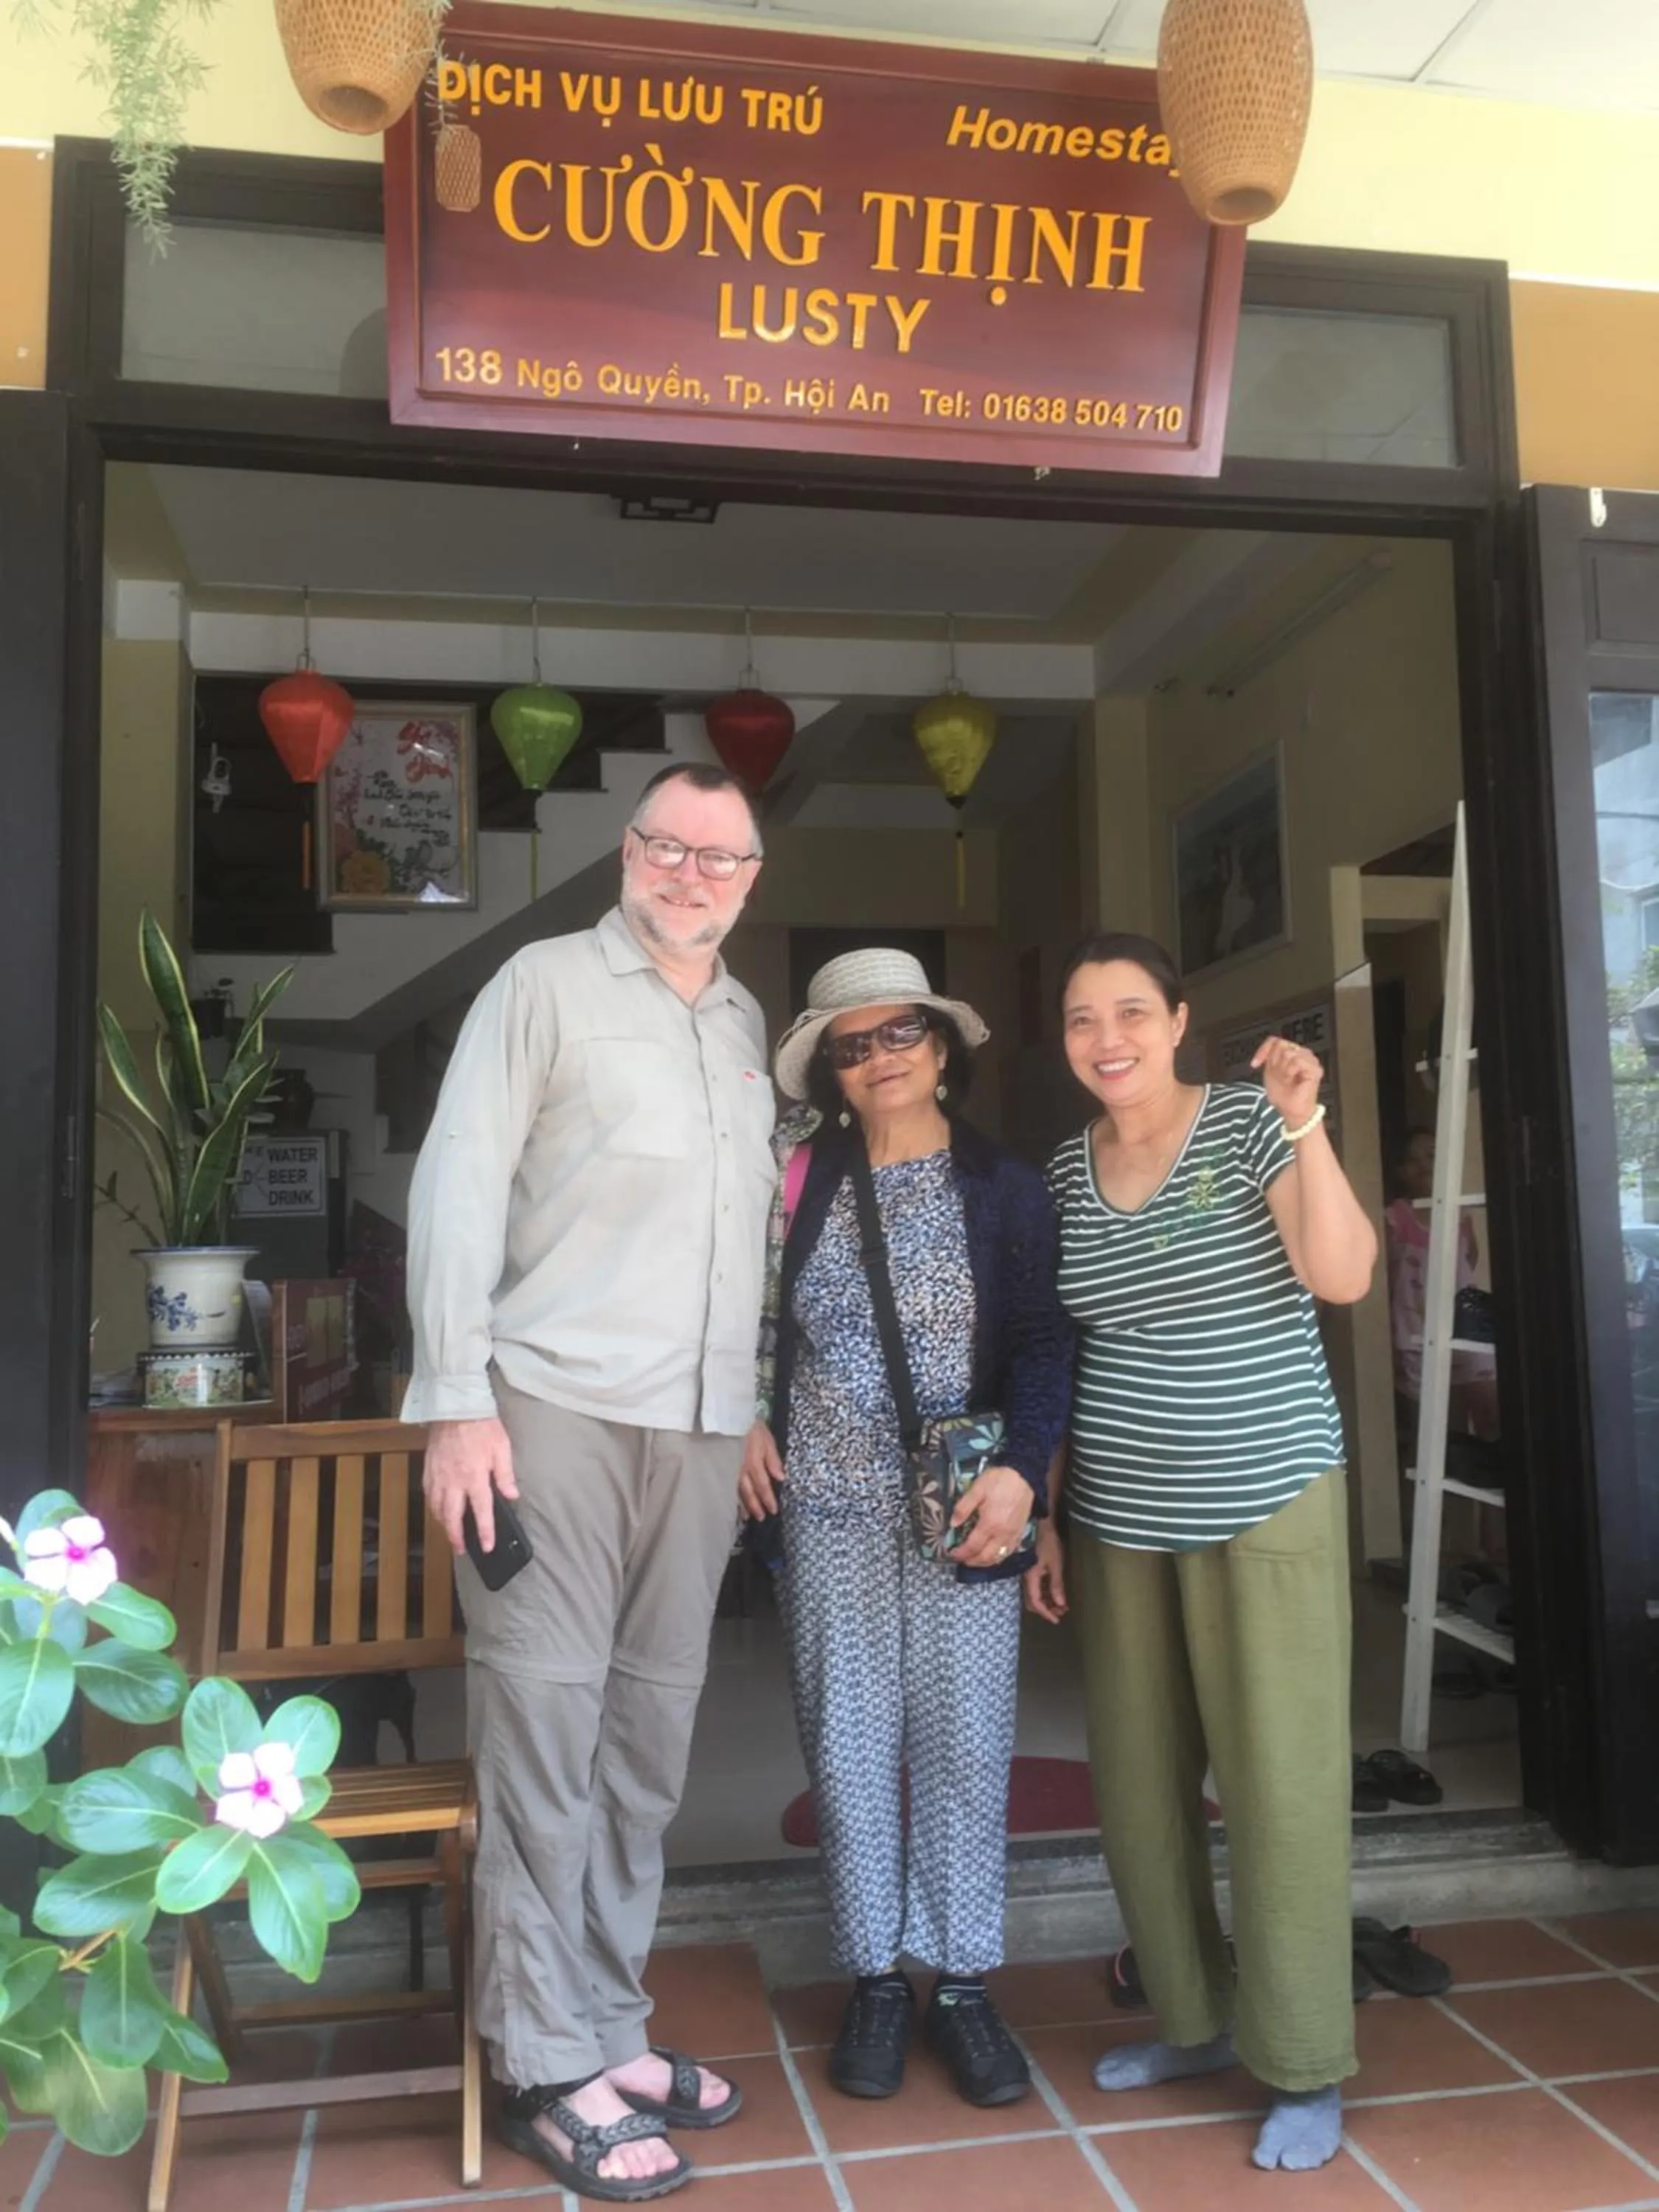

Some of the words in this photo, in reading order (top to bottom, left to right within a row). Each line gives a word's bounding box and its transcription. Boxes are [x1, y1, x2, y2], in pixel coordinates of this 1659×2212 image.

[437, 59, 543, 116] DỊCH
[560, 71, 622, 128] VỤ
[638, 76, 724, 125] LƯU
[740, 85, 824, 136] TRÚ
[946, 105, 1181, 178] Homesta
[493, 142, 825, 267] CƯỜNG
[862, 190, 1151, 306] THỊNH
[718, 282, 931, 355] LUSTY
[436, 347, 503, 385] 138
[517, 358, 583, 399] Ngô
[597, 363, 712, 406] Quyền,
[724, 375, 771, 409] Tp.
[785, 378, 835, 414] Hội
[848, 383, 890, 413] An
[919, 388, 971, 418] Tel:
[982, 392, 1068, 425] 01638
[1074, 400, 1128, 429] 504
[1137, 403, 1183, 432] 710
[267, 1147, 319, 1164] WATER
[268, 1169, 307, 1185] BEER
[268, 1189, 314, 1206] DRINK
